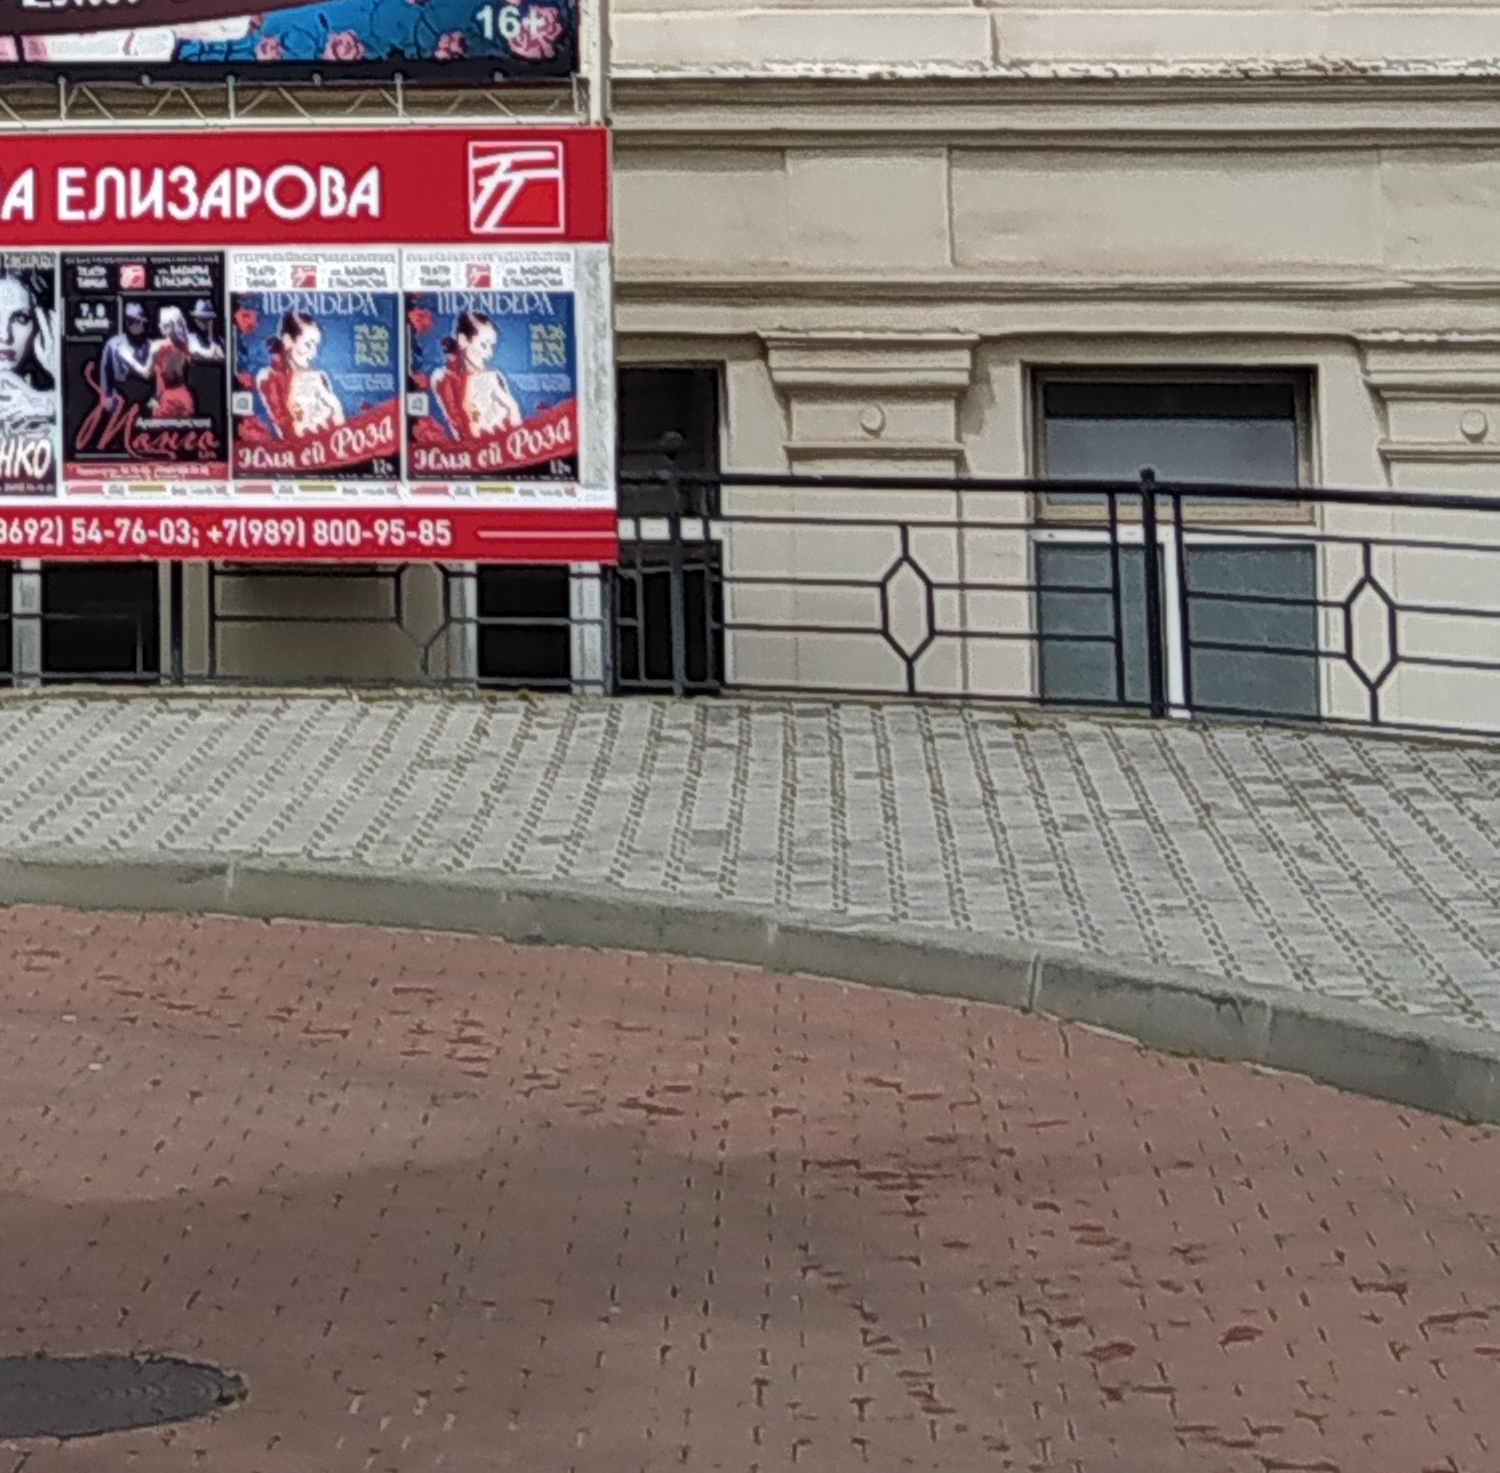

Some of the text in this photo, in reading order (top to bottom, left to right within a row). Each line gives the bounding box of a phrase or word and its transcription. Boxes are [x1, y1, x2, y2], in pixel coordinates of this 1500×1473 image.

[476, 4, 546, 41] 16+
[56, 163, 381, 222] ЕЛИЗАРОВА
[207, 516, 306, 547] +7(989)
[312, 517, 452, 547] 800-95-85
